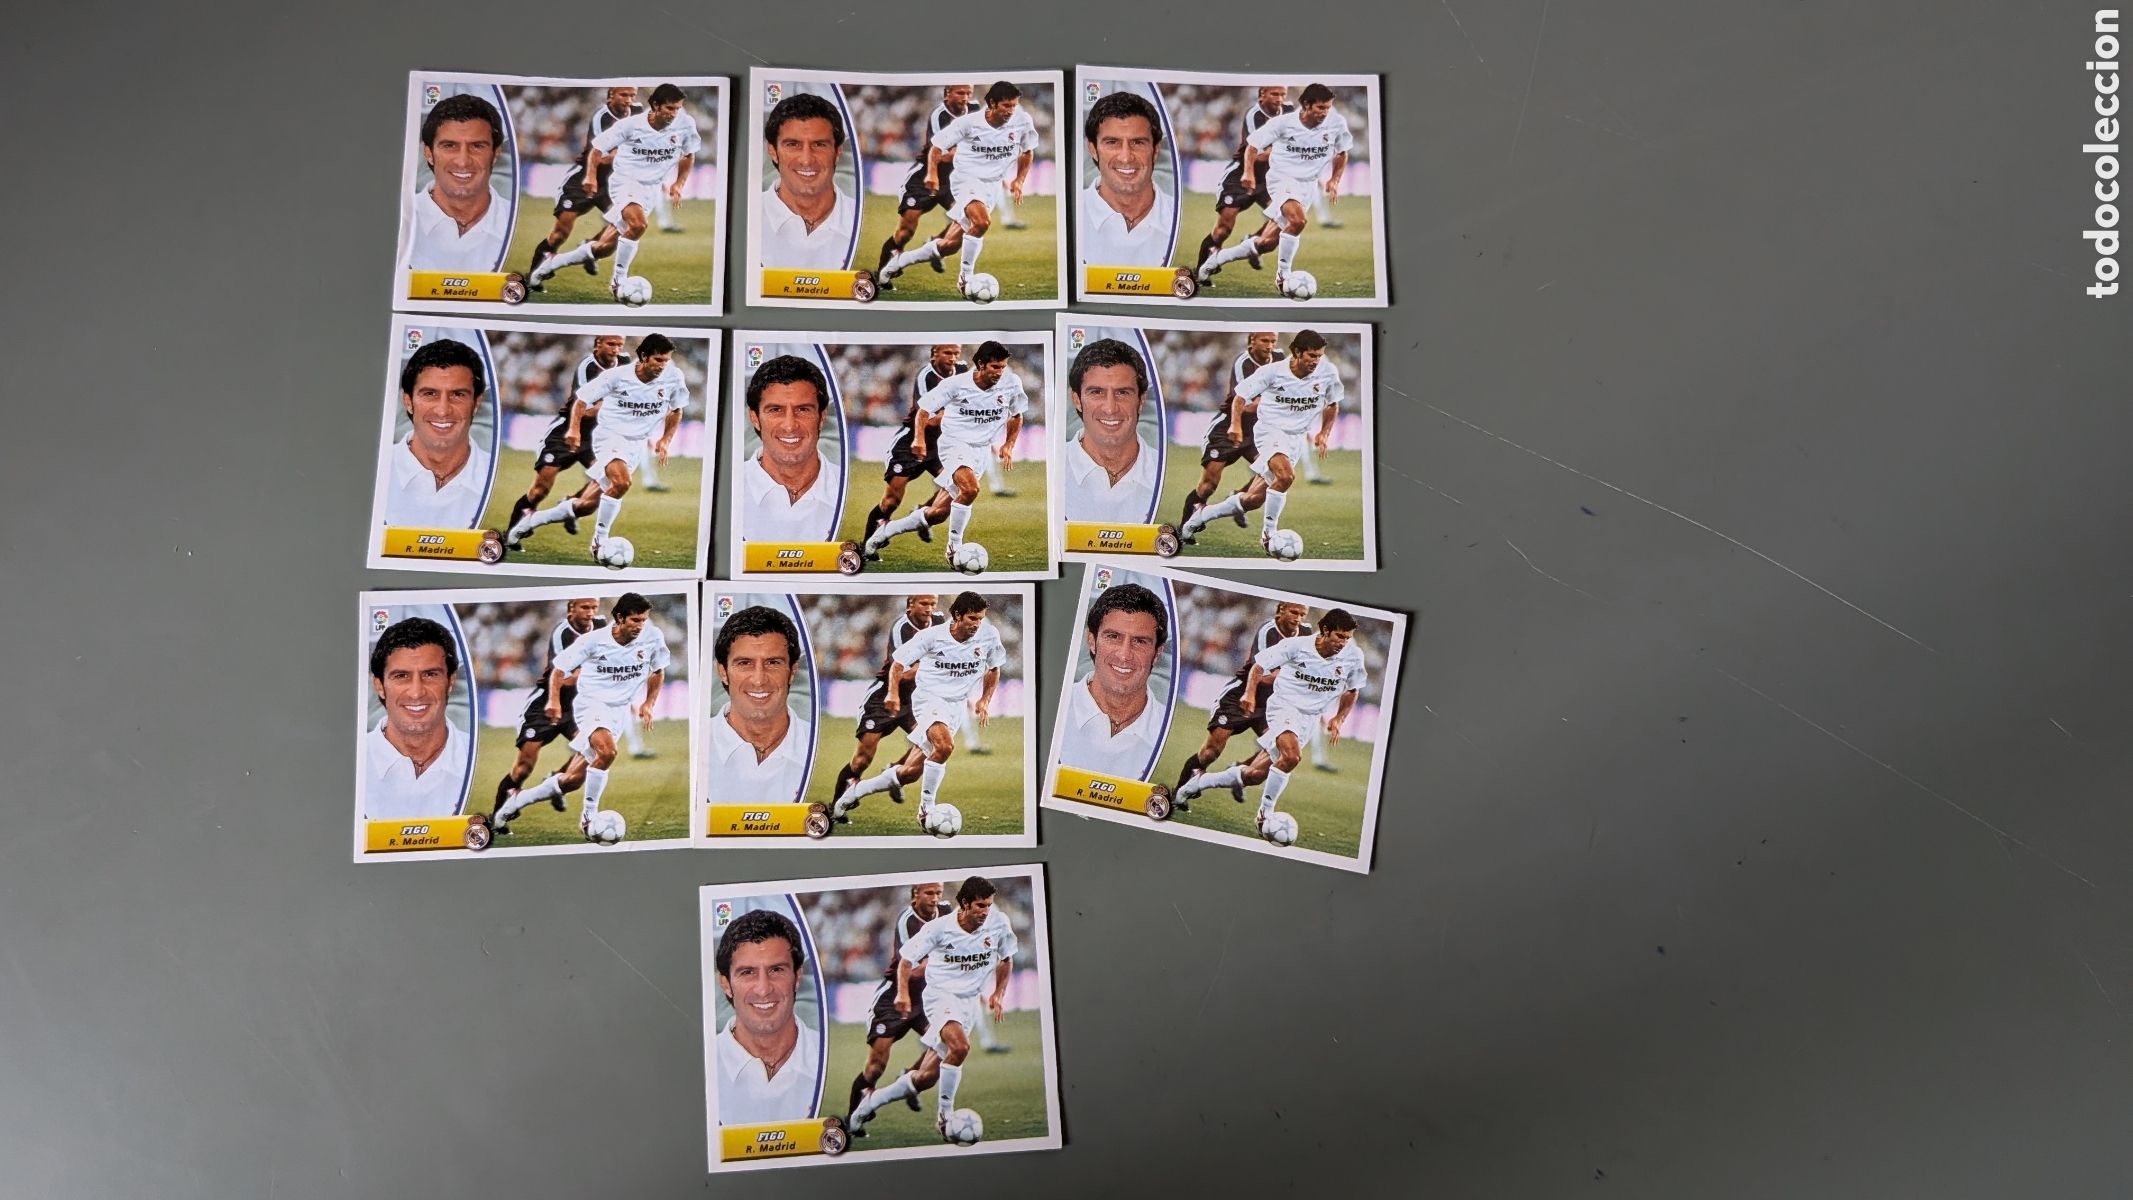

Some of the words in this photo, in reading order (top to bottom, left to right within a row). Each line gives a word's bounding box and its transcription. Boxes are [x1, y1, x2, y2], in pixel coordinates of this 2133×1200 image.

[971, 144, 1015, 153] SIEMENS
[1286, 145, 1329, 153] SIEMENS
[442, 278, 468, 287] FIGO
[794, 277, 820, 285] FIGO
[796, 287, 829, 295] Madrid
[1275, 395, 1319, 403] SIEMENS
[618, 400, 663, 408] SIEMENS
[959, 407, 1003, 416] SIEMENS
[1099, 530, 1123, 539] FIGO
[418, 535, 445, 544] FIGO
[1100, 541, 1132, 549] Madrid
[418, 546, 454, 555] Madrid
[778, 550, 804, 558] FIGO
[779, 560, 813, 568] Madrid
[596, 664, 643, 673] SIEMENS
[935, 661, 979, 670] SIEMENS
[1295, 671, 1339, 685] SIEMENS
[1090, 780, 1116, 792] FIGO
[1077, 789, 1085, 797] R.
[1089, 791, 1123, 804] Madrid
[742, 812, 770, 821] FIGO
[401, 826, 429, 835] FIGO
[745, 823, 780, 831] Madrid
[403, 836, 439, 845] Madrid
[944, 951, 990, 962] SIEMENS
[757, 1131, 785, 1142] FIGO
[760, 1142, 796, 1152] Madrid
